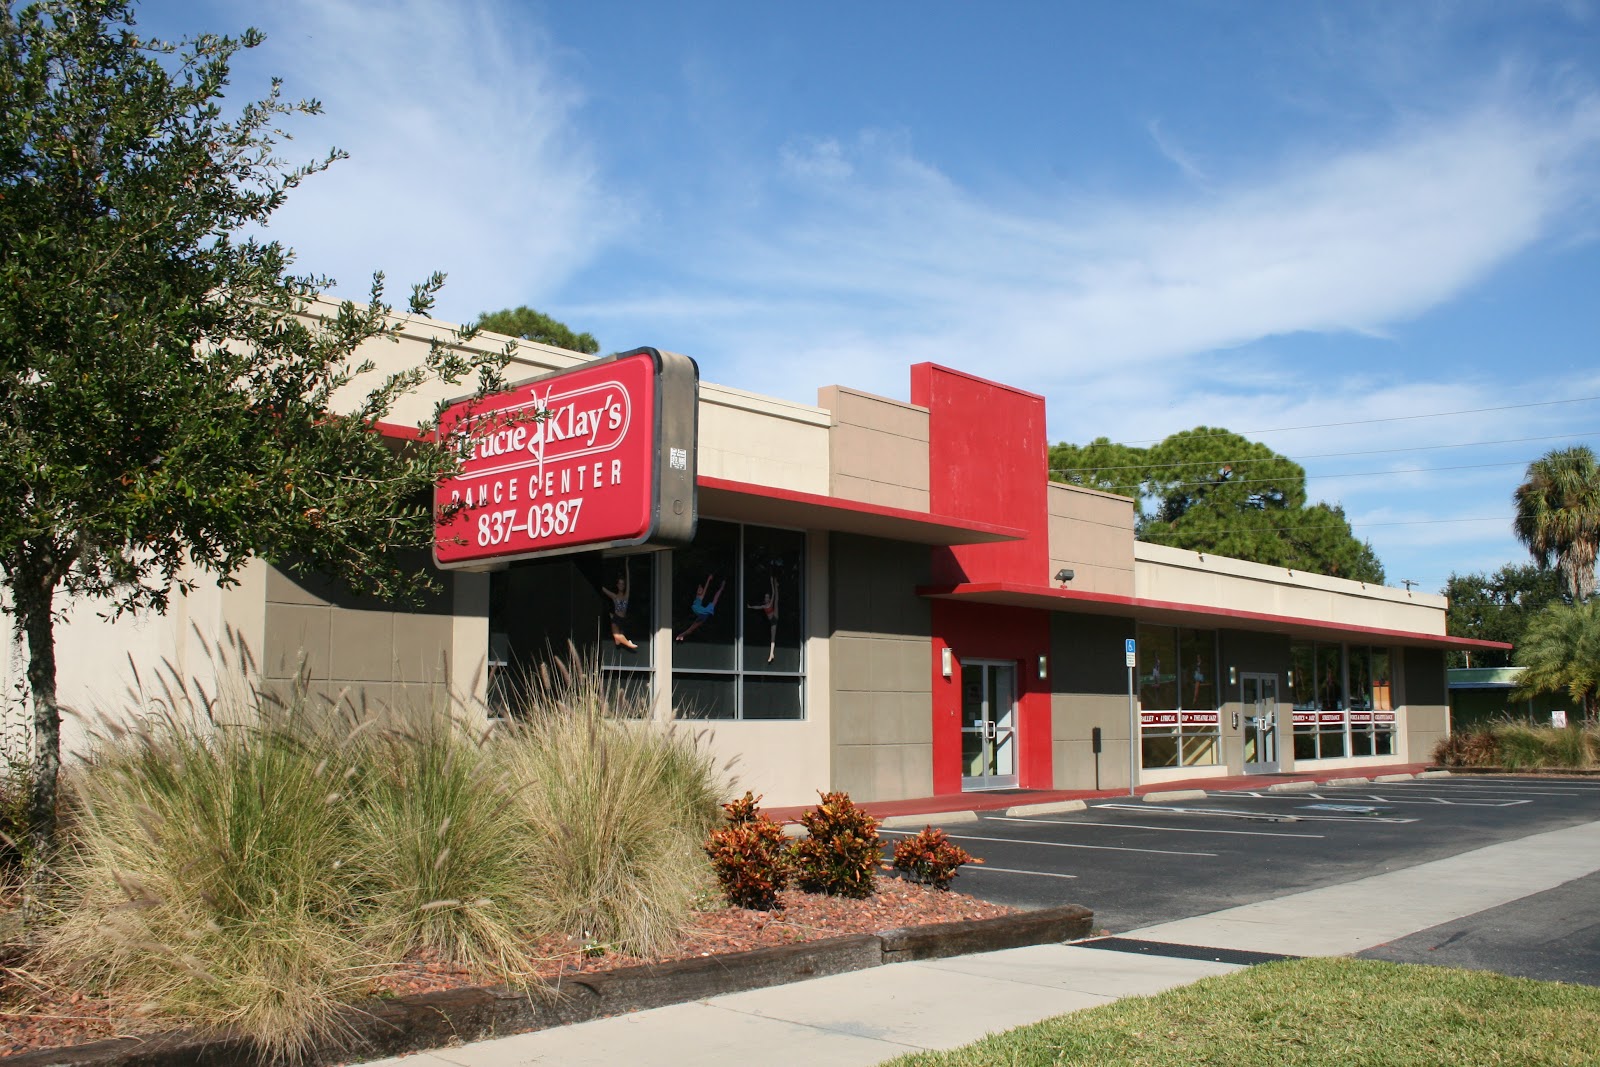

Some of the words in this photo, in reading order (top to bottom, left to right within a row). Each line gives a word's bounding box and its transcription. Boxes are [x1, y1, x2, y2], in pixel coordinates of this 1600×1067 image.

[545, 395, 622, 447] Klay's
[452, 478, 518, 509] DANCE
[529, 459, 622, 499] CENTER
[477, 498, 583, 547] 837-0387
